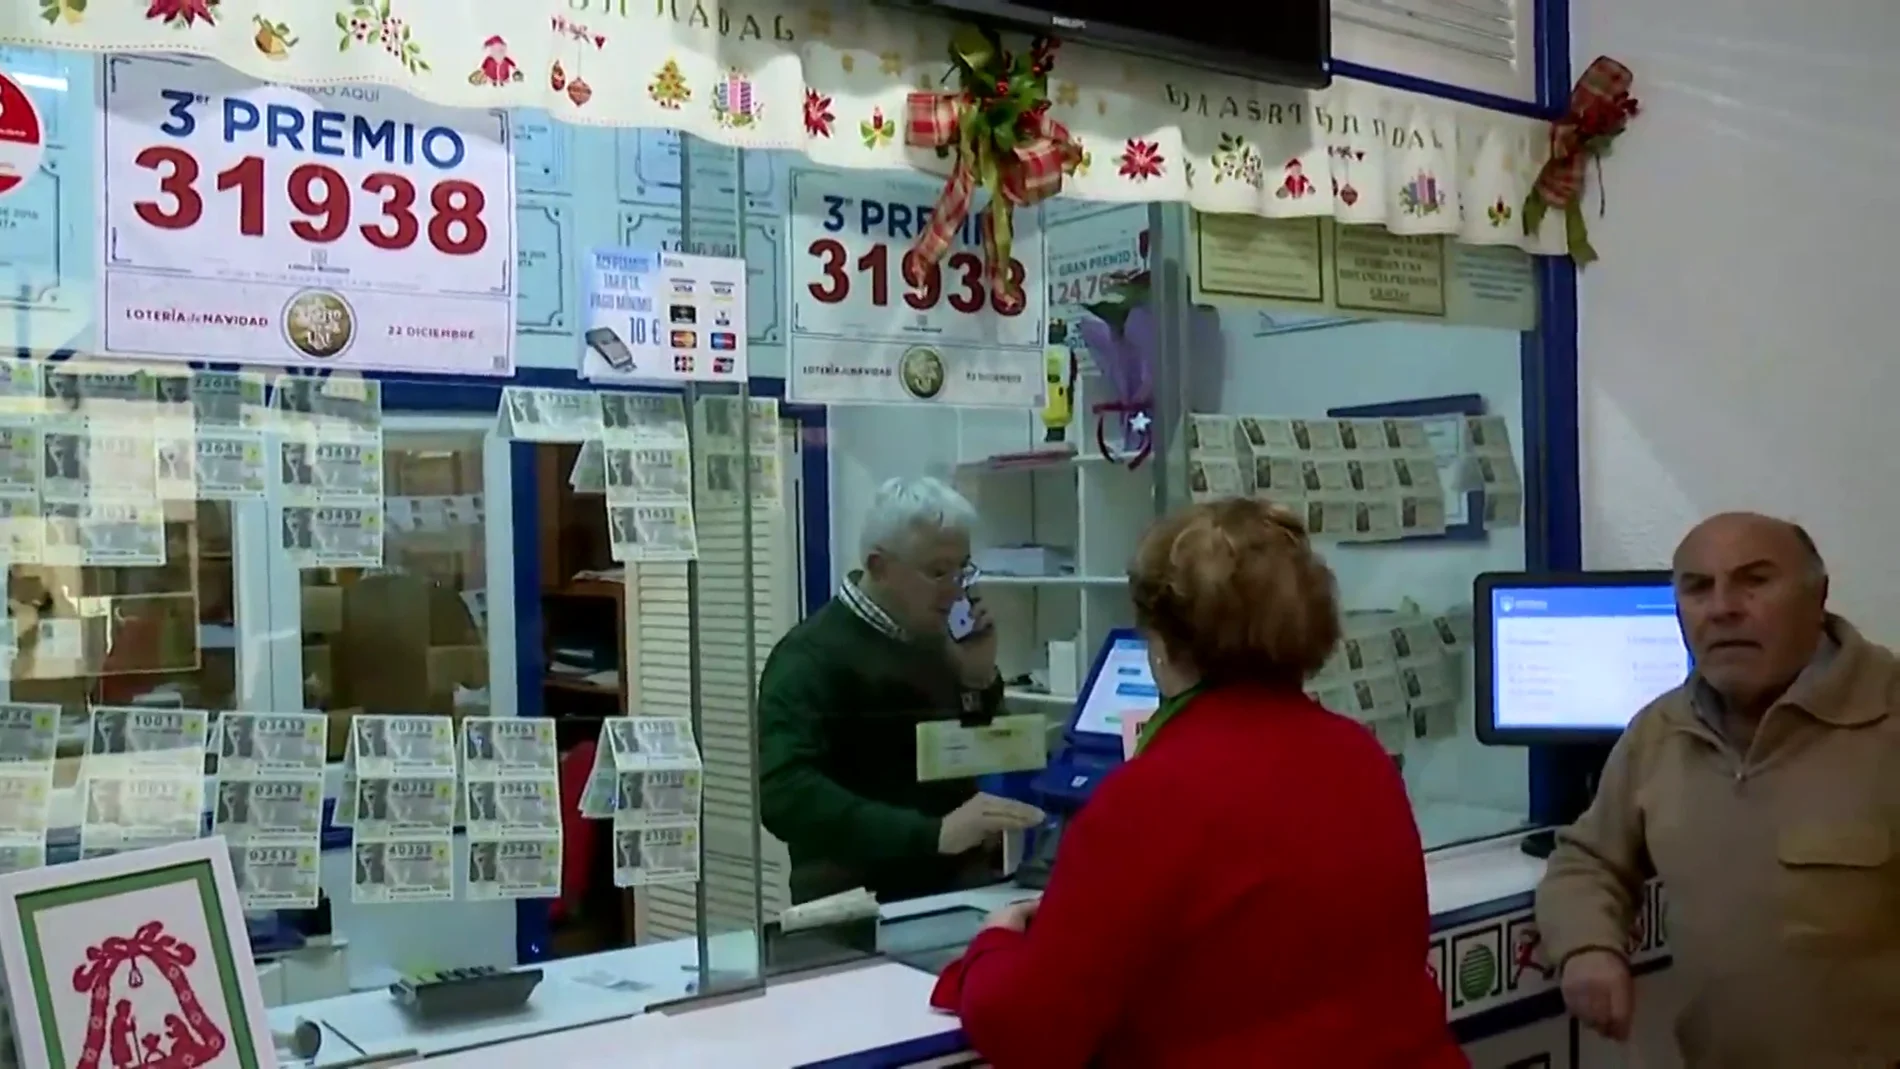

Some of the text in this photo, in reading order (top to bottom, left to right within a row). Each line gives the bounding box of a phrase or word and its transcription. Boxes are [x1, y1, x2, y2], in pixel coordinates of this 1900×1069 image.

[223, 97, 465, 170] PREMIO
[133, 146, 488, 256] 31938
[1089, 250, 1131, 269] PREMIO
[807, 239, 1027, 317] 31938
[125, 307, 186, 322] LOTERÍA
[202, 313, 269, 328] NAVIDAD
[629, 317, 646, 345] 10
[406, 326, 476, 340] DICIEMBRE
